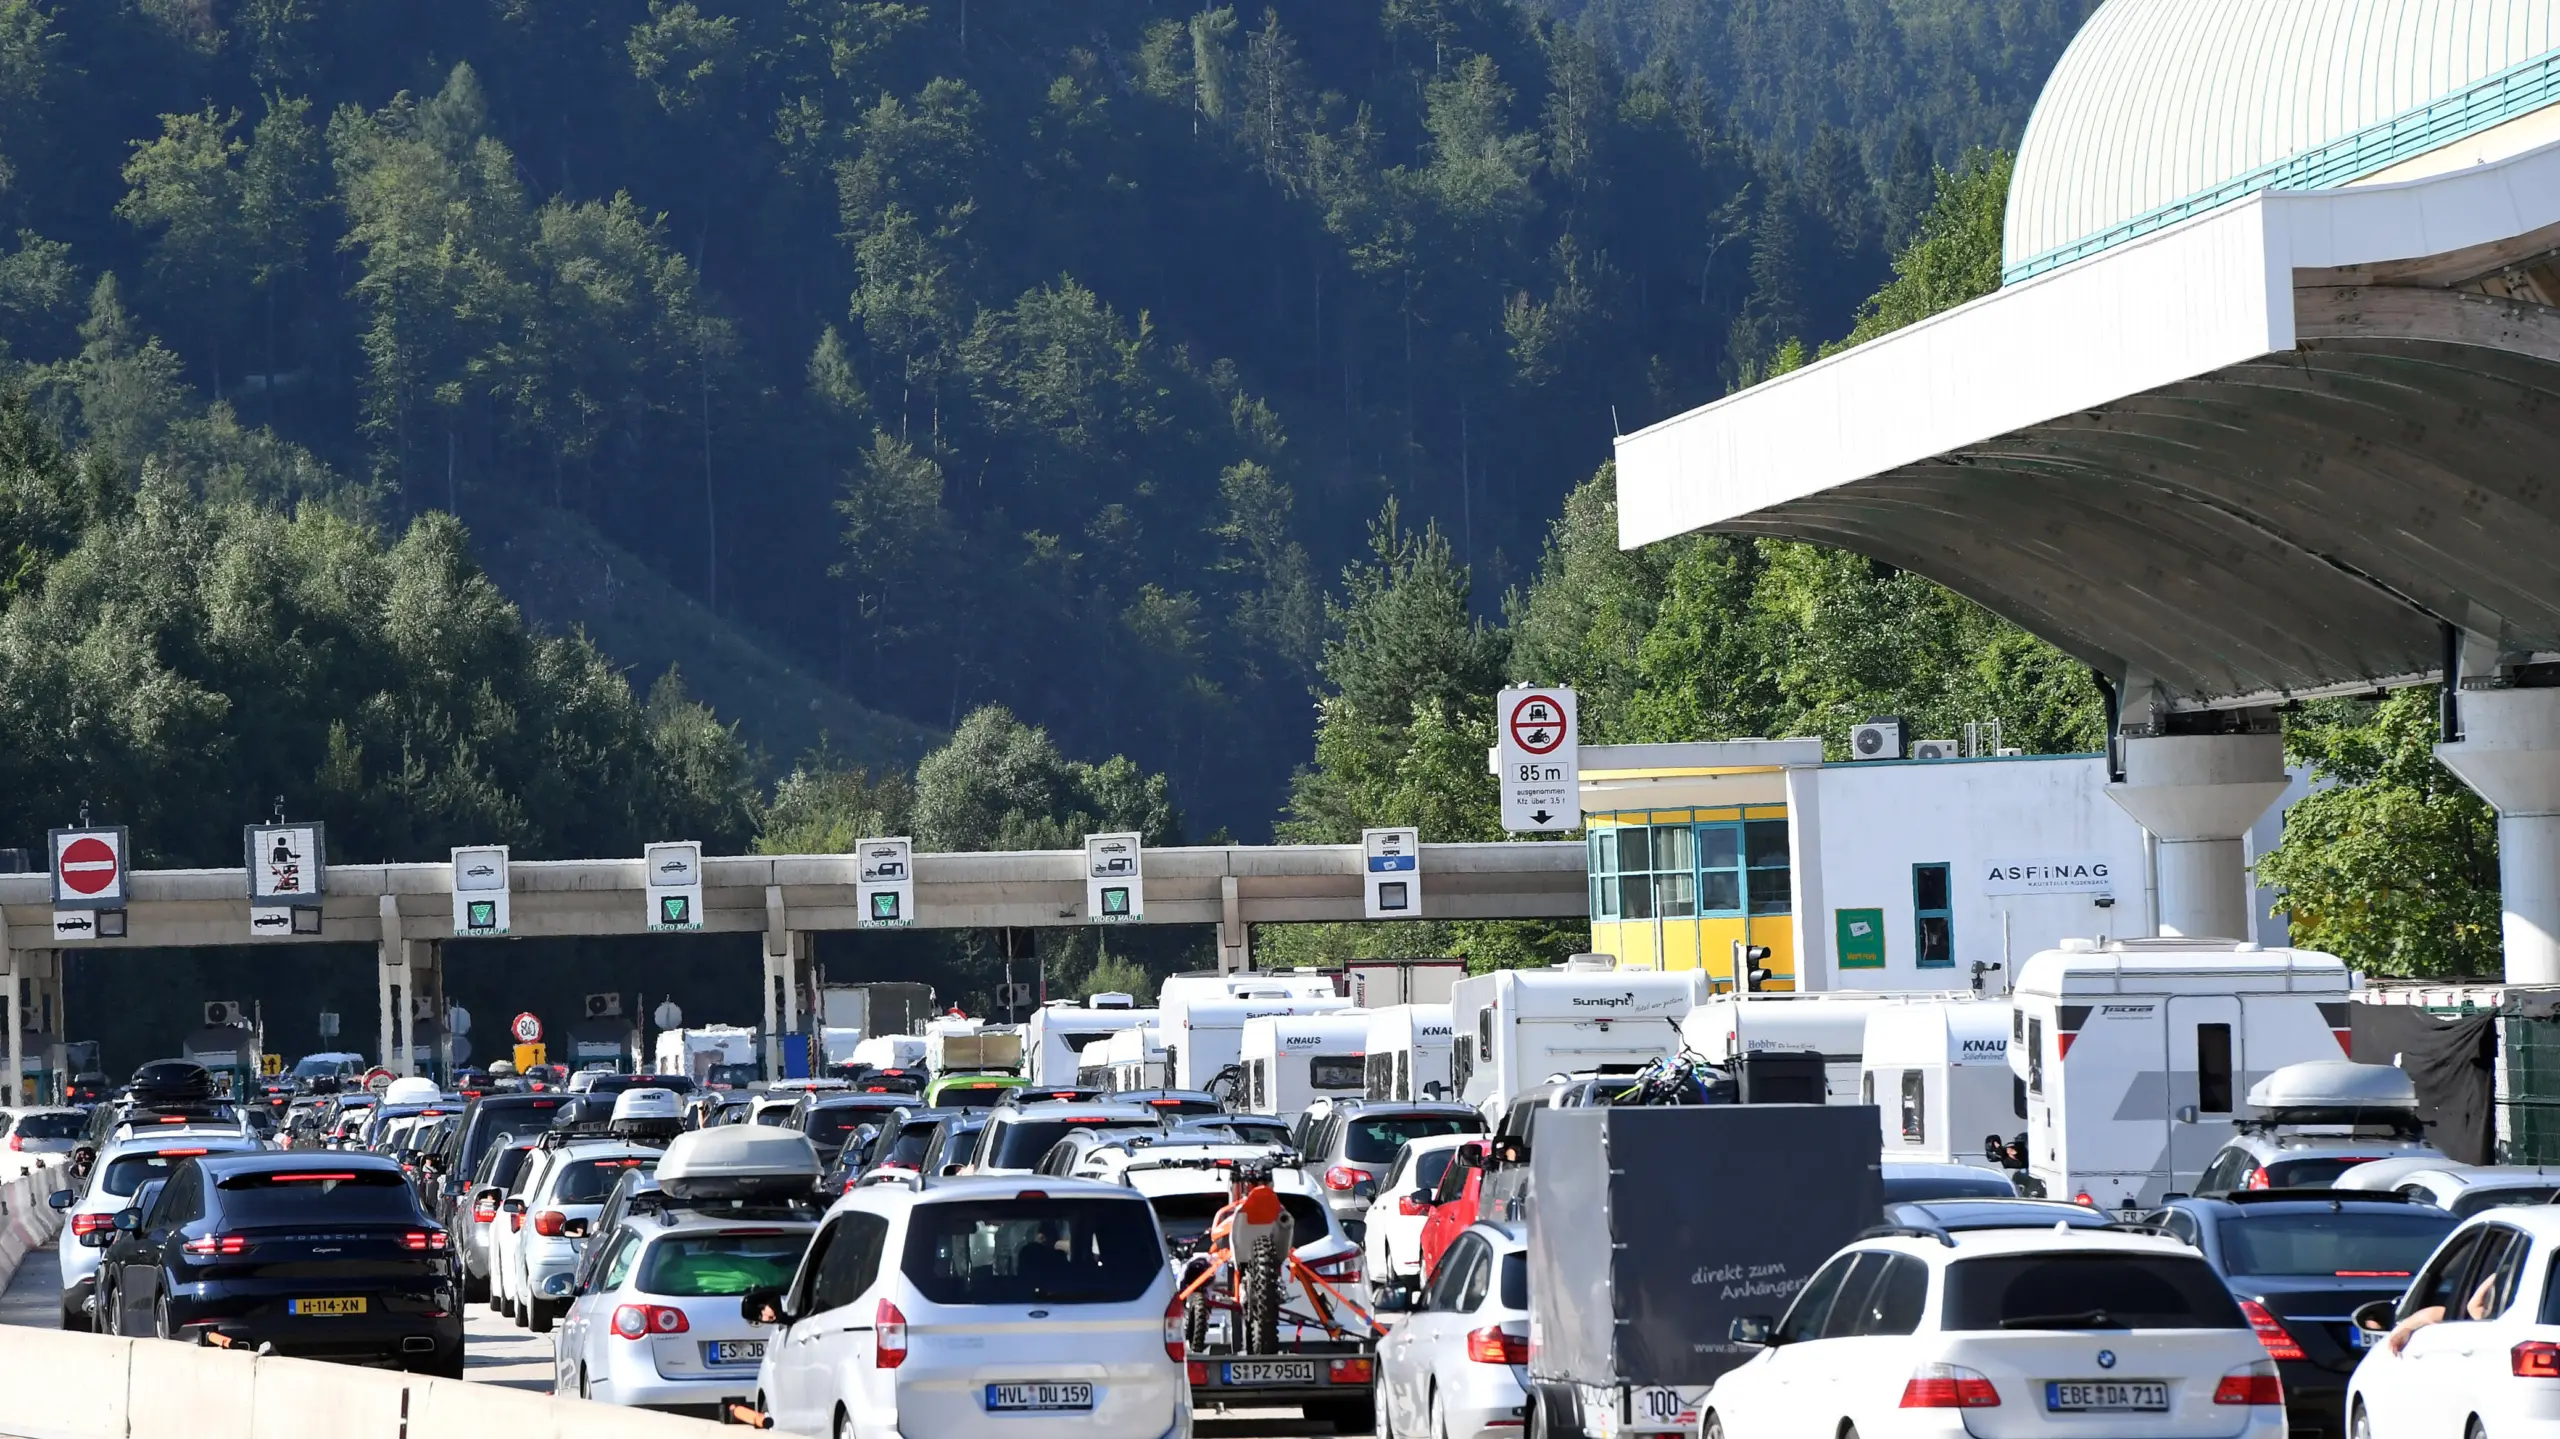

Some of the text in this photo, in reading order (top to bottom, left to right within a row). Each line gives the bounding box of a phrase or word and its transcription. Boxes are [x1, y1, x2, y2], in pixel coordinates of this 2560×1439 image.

[1520, 765, 1561, 781] 85 m
[1516, 788, 1566, 797] ausgenommen
[1531, 797, 1546, 805] über
[1572, 997, 1629, 1008] Sunlight
[521, 1020, 536, 1036] 80
[1286, 1036, 1321, 1045] KNAUS
[1748, 1039, 1777, 1049] Hobby
[1691, 1263, 1786, 1285] direkt zum
[303, 1299, 359, 1313] H-114-XN
[719, 1342, 765, 1358] ES JB
[1232, 1363, 1313, 1380] S PZ 9501
[998, 1386, 1089, 1404] HVL DU 159
[2060, 1386, 2165, 1405] EBE DA 711
[1646, 1390, 1678, 1417] 100
